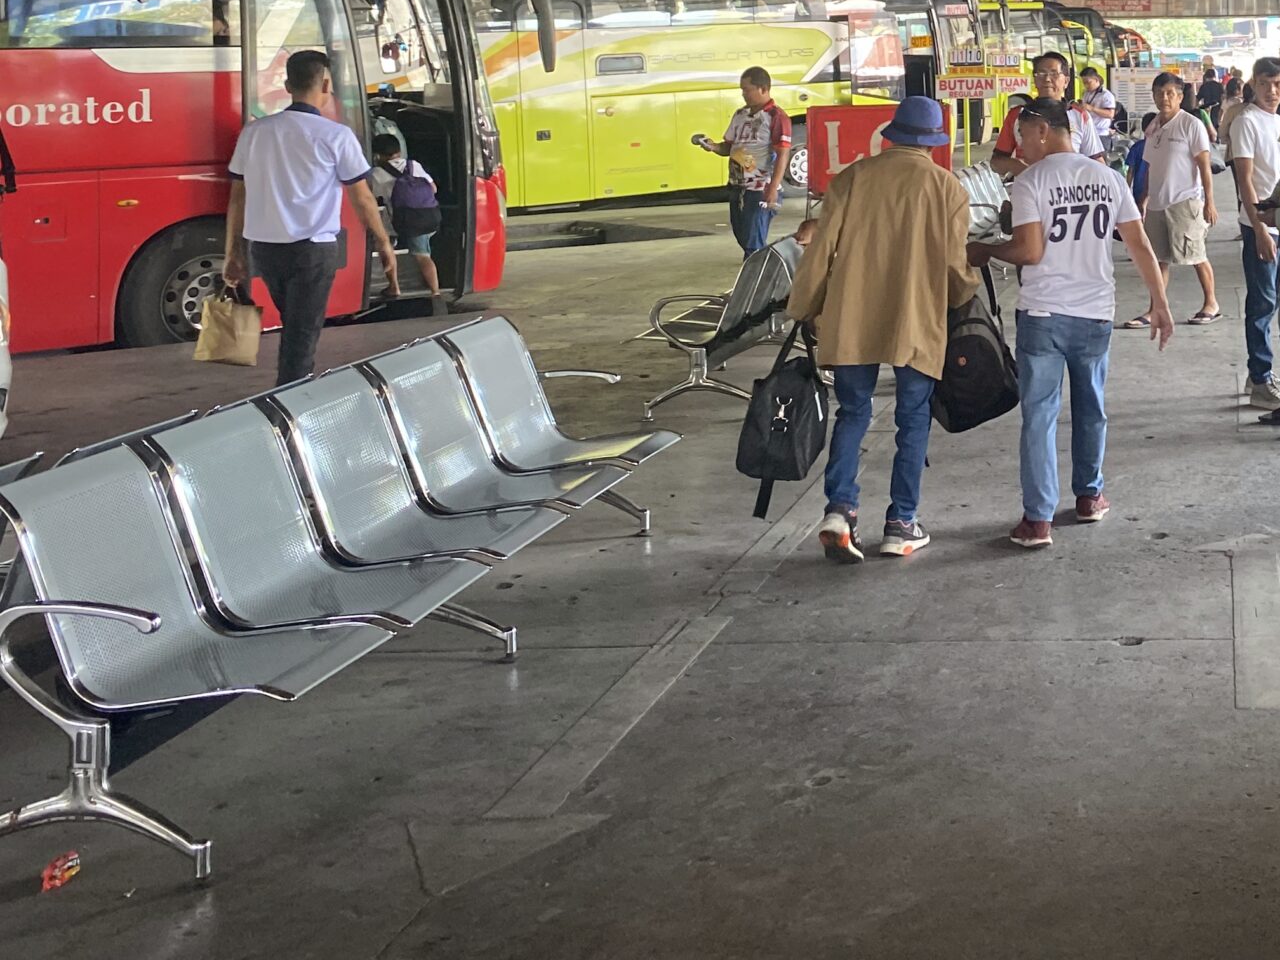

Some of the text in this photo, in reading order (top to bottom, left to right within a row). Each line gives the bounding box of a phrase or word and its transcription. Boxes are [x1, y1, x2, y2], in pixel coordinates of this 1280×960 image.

[648, 47, 814, 64] BACHELOR TOURS
[939, 80, 994, 91] BUTUAN
[999, 78, 1028, 87] TUAN
[0, 88, 152, 127] orated
[1048, 183, 1113, 207] J.PANOCHOL
[1048, 203, 1110, 243] 570
